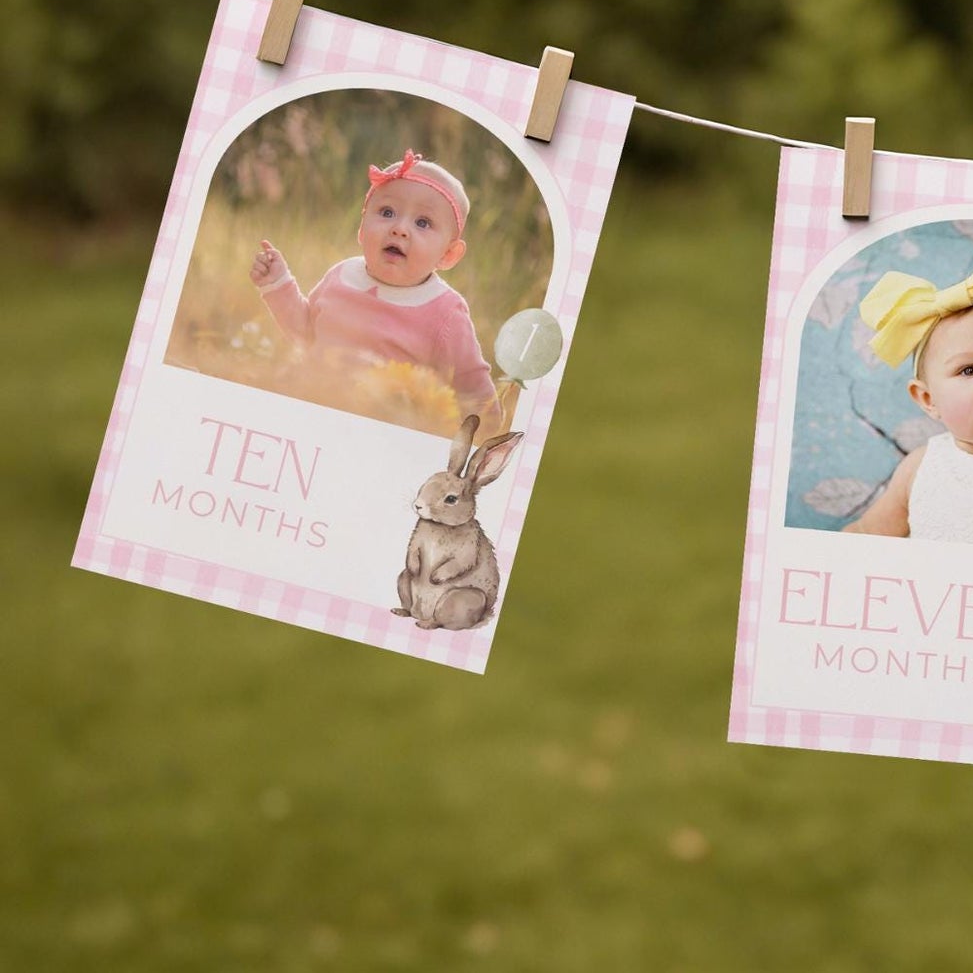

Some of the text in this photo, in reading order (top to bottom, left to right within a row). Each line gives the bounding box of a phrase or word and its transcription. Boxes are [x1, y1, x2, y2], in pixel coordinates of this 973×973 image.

[520, 323, 539, 361] 1
[200, 417, 321, 501] TEN
[151, 479, 328, 548] MONTHS
